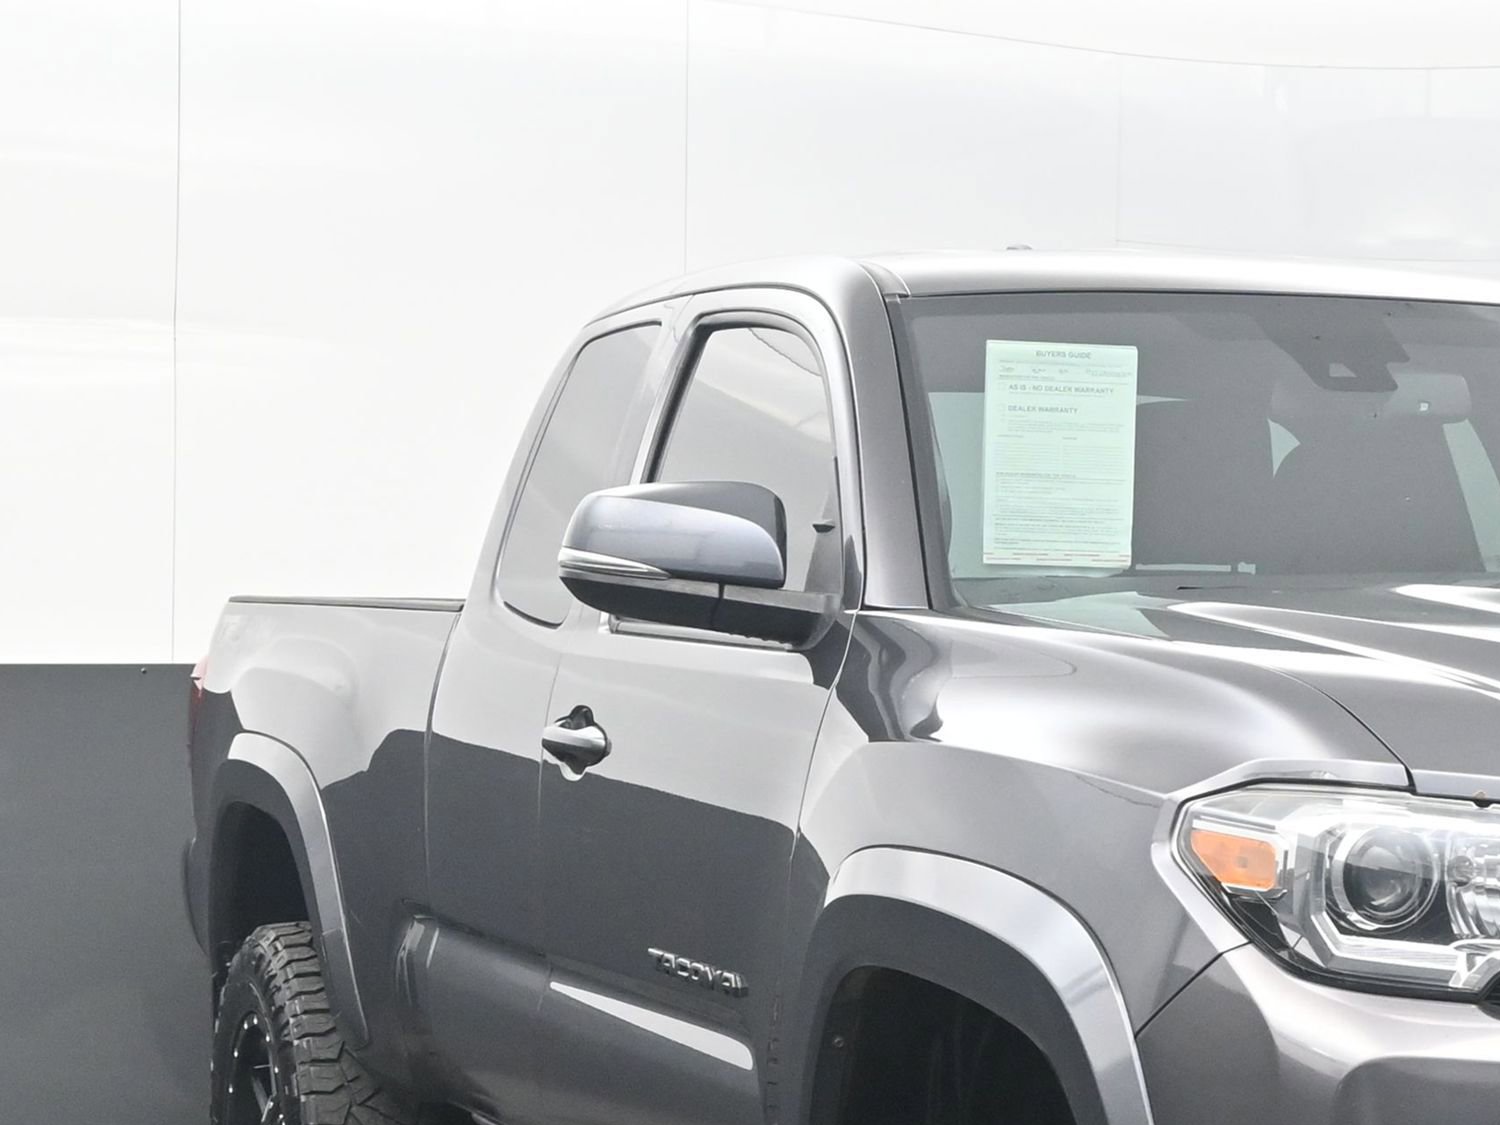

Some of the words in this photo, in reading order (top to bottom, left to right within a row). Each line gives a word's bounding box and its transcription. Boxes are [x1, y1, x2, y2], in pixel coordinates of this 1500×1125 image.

[1035, 350, 1067, 358] BUYERS
[1068, 351, 1092, 359] GUIDE
[1008, 383, 1018, 391] AS
[1032, 384, 1043, 392] NO
[1044, 385, 1073, 393] DEALER
[1074, 386, 1115, 394] WARRANTY
[1007, 404, 1036, 413] DEALER
[1038, 406, 1079, 414] WARRANTY
